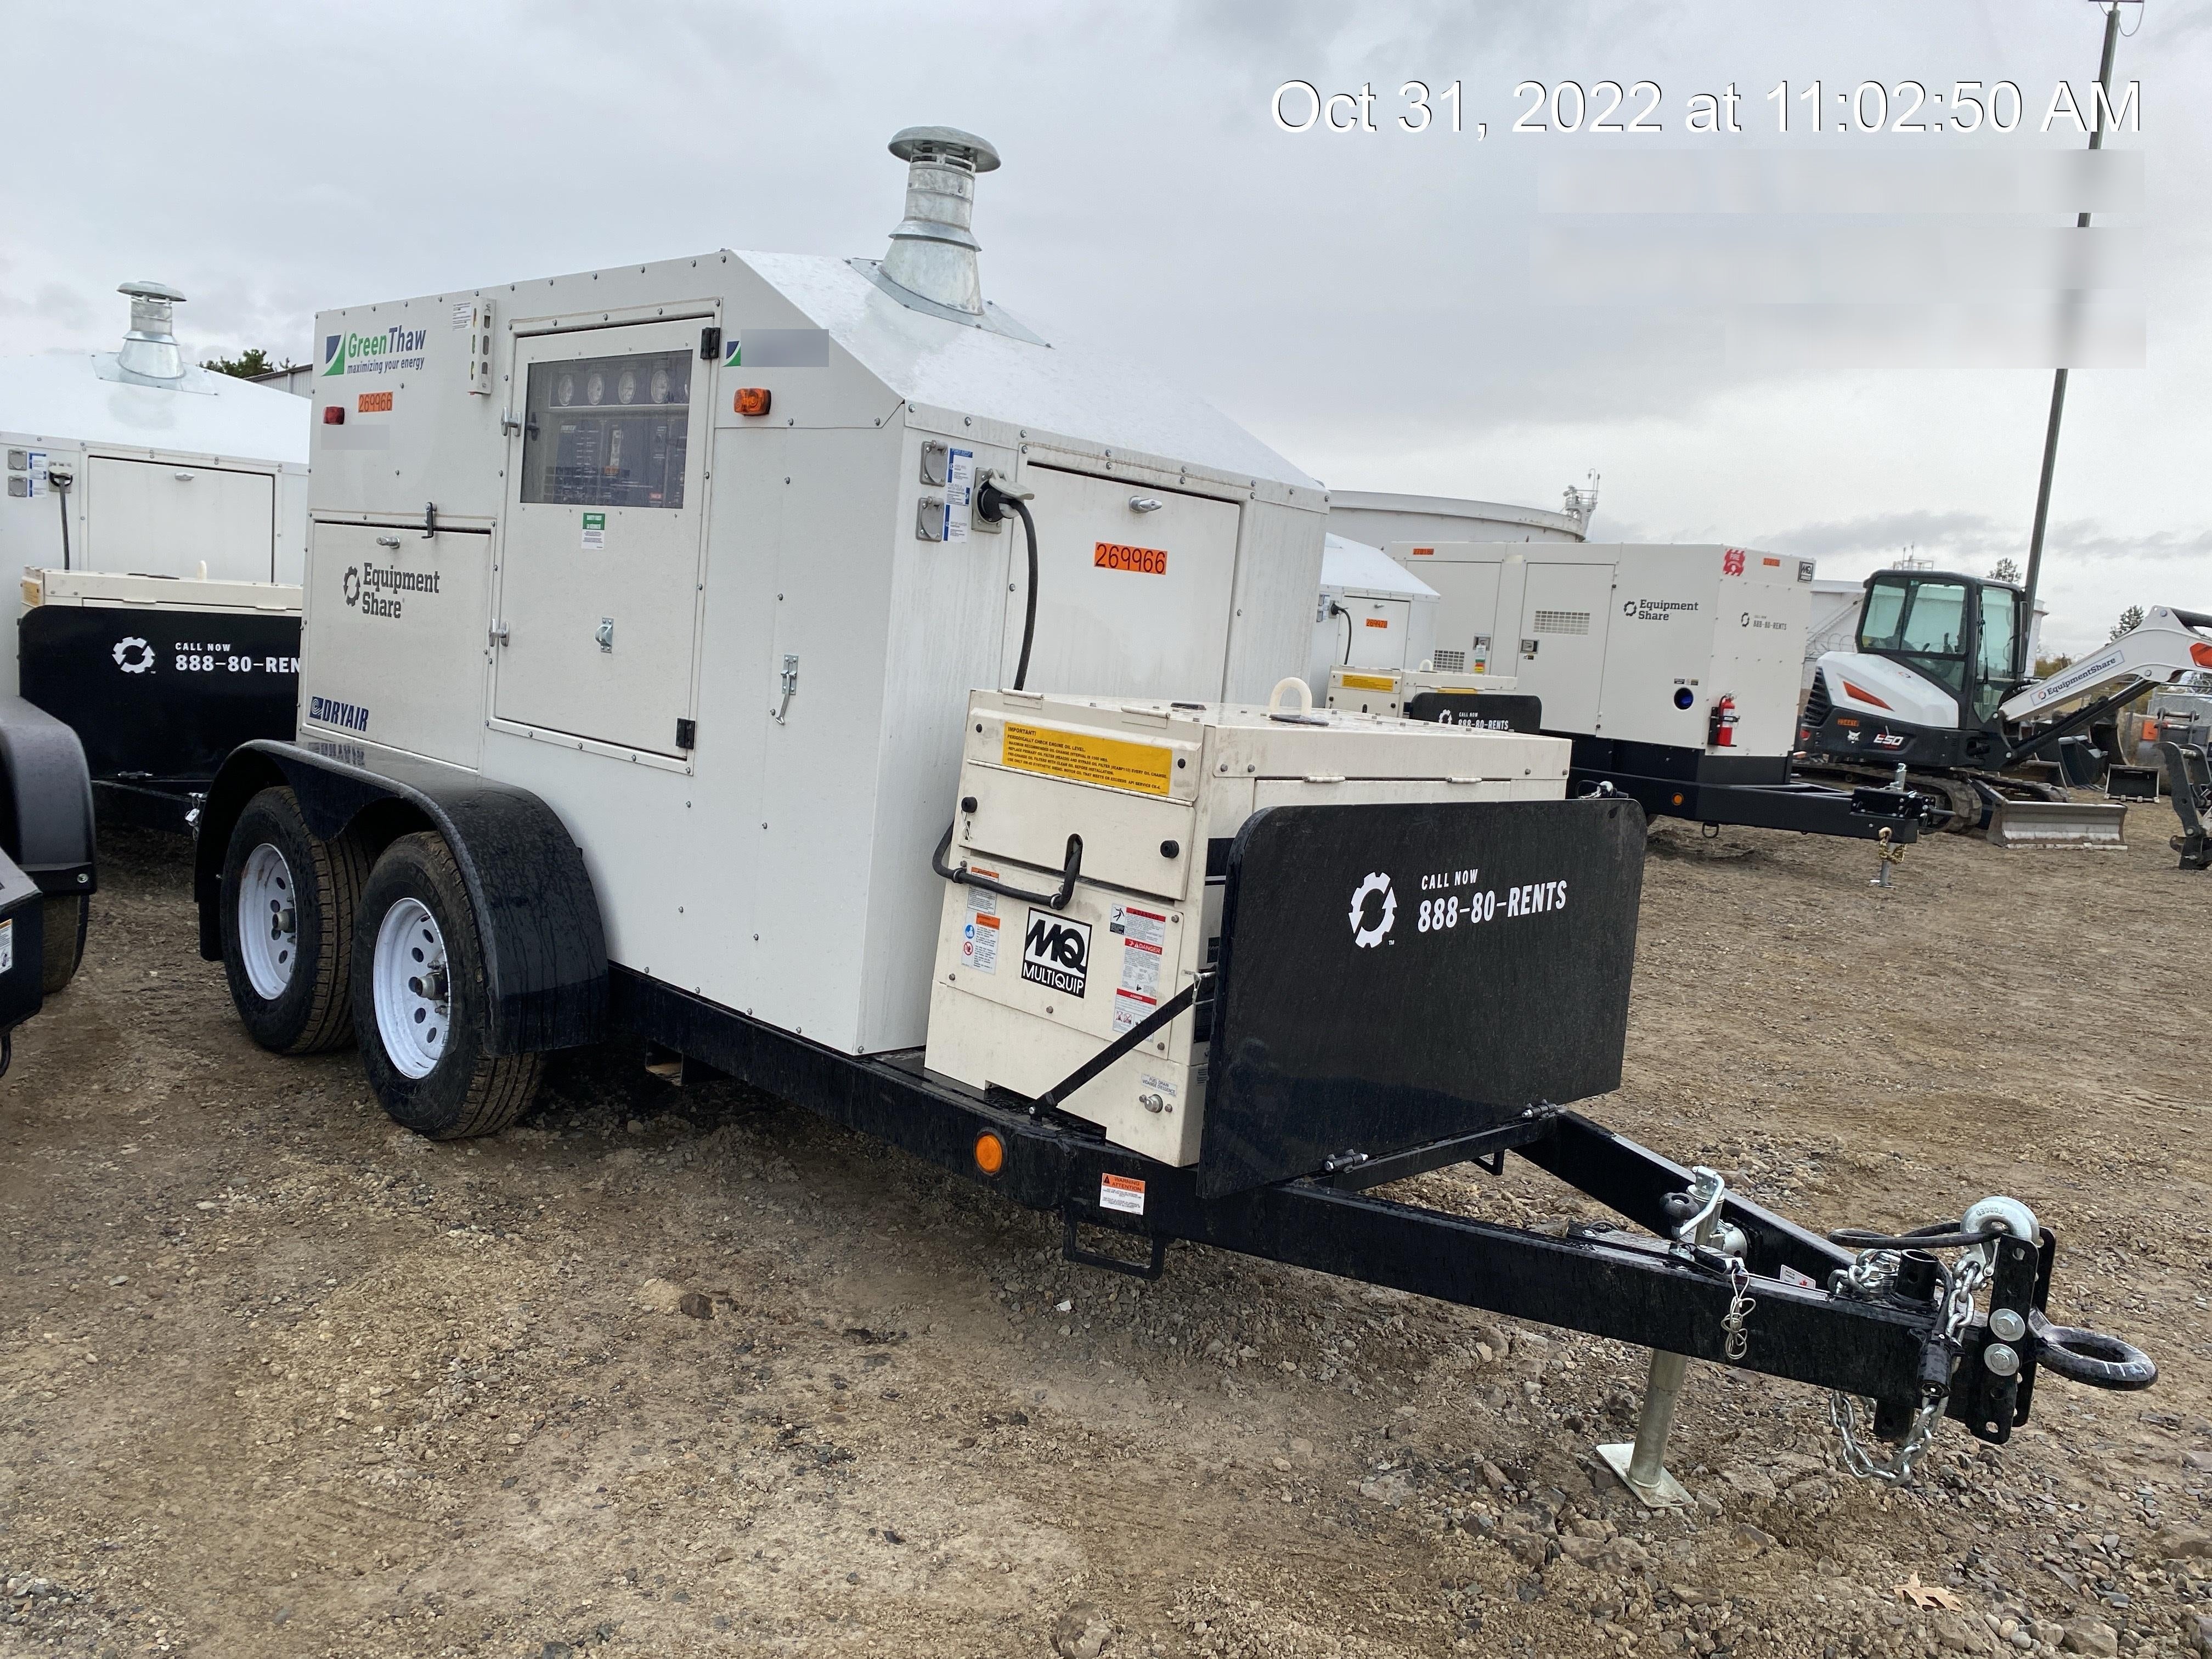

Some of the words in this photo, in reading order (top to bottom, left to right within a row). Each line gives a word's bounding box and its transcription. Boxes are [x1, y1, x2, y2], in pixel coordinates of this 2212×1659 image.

[348, 325, 426, 358] GreenThaw
[347, 359, 382, 374] maximizing
[385, 359, 398, 371] your
[400, 357, 425, 370] energy
[359, 393, 392, 412] 269966
[1096, 544, 1165, 574] 269966
[363, 562, 440, 594] Equipment
[362, 591, 401, 618] Share
[1640, 599, 1699, 611] Equipment
[1639, 611, 1669, 620] Share
[175, 642, 202, 651] CALL
[207, 644, 230, 652] NOW
[175, 655, 300, 673] 888-80-REN
[2047, 658, 2116, 695] EquipmentShare
[322, 699, 369, 732] DRYAIR
[1008, 726, 1036, 736] IMPORTANT!
[1458, 719, 1509, 730] 888-80-RENTS
[1007, 734, 1033, 742] PERIODICALLY
[1874, 733, 1904, 746] E50
[1421, 872, 1448, 890] CALL
[1455, 868, 1479, 886] NOW
[1418, 880, 1567, 933] 888-80-RENTS
[1025, 919, 1086, 974] MQ
[1139, 943, 1161, 953] DANGER
[1023, 962, 1084, 994] MULTIQUIP
[1111, 1182, 1142, 1192] ATTENTION
[1114, 1177, 1140, 1186] WARNING
[1976, 1206, 2004, 1216] FORGED
